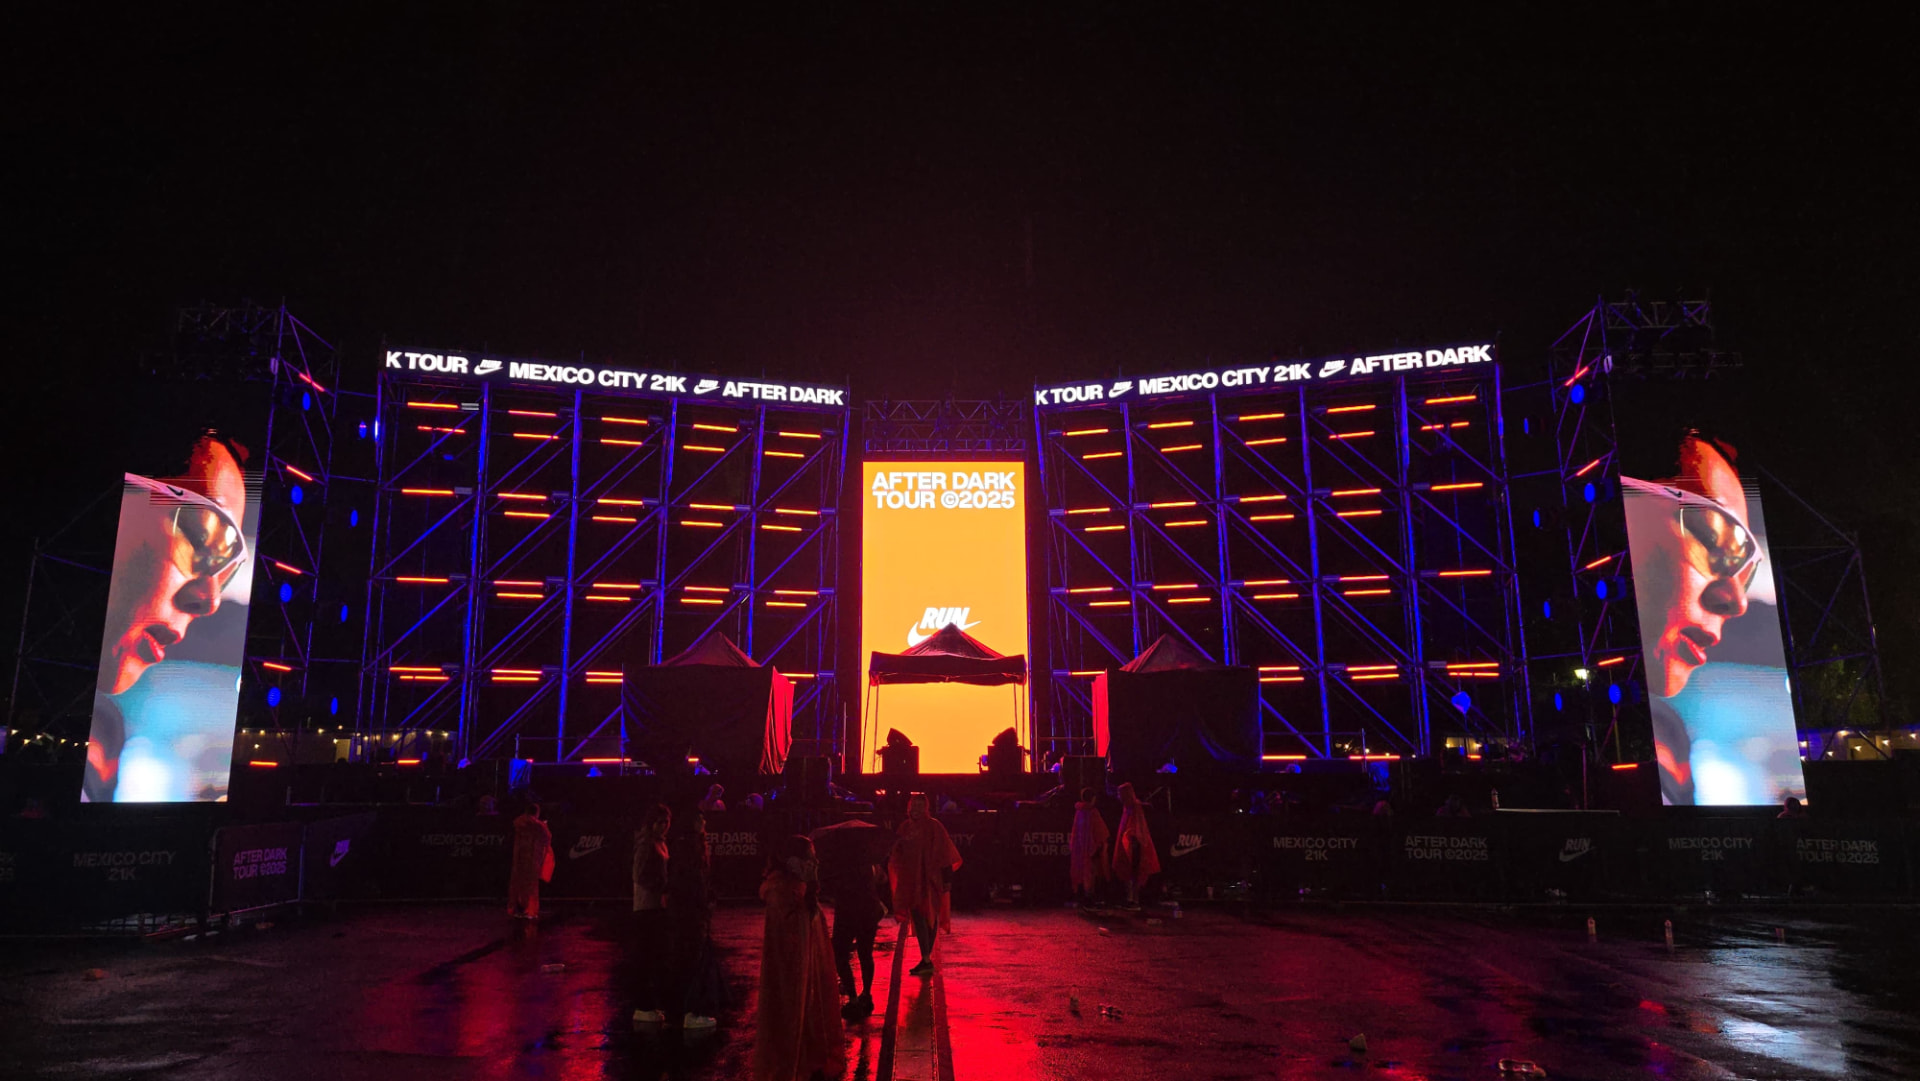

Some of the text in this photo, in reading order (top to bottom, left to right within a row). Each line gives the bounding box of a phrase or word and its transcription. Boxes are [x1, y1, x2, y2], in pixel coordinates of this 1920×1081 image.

[404, 352, 469, 374] TOUR
[509, 361, 596, 385] MEXICO
[598, 369, 648, 389] CITY
[650, 373, 687, 393] 21K
[722, 381, 787, 401] AFTER
[789, 386, 844, 406] DARK
[1050, 384, 1104, 404] TOUR
[1139, 371, 1219, 395] MEXICO
[1221, 366, 1270, 387] CITY
[1273, 363, 1312, 382] 21K
[1350, 351, 1423, 375] AFTER
[1425, 344, 1493, 368] DARK
[872, 472, 1016, 490] AFTER DARK
[872, 491, 1016, 509] TOUR ©2025
[919, 607, 971, 630] RUN
[475, 834, 505, 846] CITY
[577, 835, 605, 848] RUN
[722, 832, 760, 844] DARK
[1022, 832, 1065, 843] AFTER
[1176, 833, 1202, 847] RUN
[1273, 836, 1358, 849] MEXICO CITY
[1405, 835, 1488, 849] AFTER DARK
[1565, 837, 1591, 851] RUN
[1668, 837, 1753, 850] MEXICO CITY
[1022, 844, 1059, 856] TOUR
[1796, 838, 1878, 852] AFTER DARK
[73, 850, 176, 868] MEXICO CITY
[233, 847, 287, 866] AFTER DARK
[1305, 849, 1328, 861] 21K
[1405, 847, 1442, 860] TOUR
[1701, 849, 1725, 861] 21K
[1797, 850, 1834, 862] TOUR
[108, 867, 136, 881] 21K
[233, 863, 258, 880] TOUR
